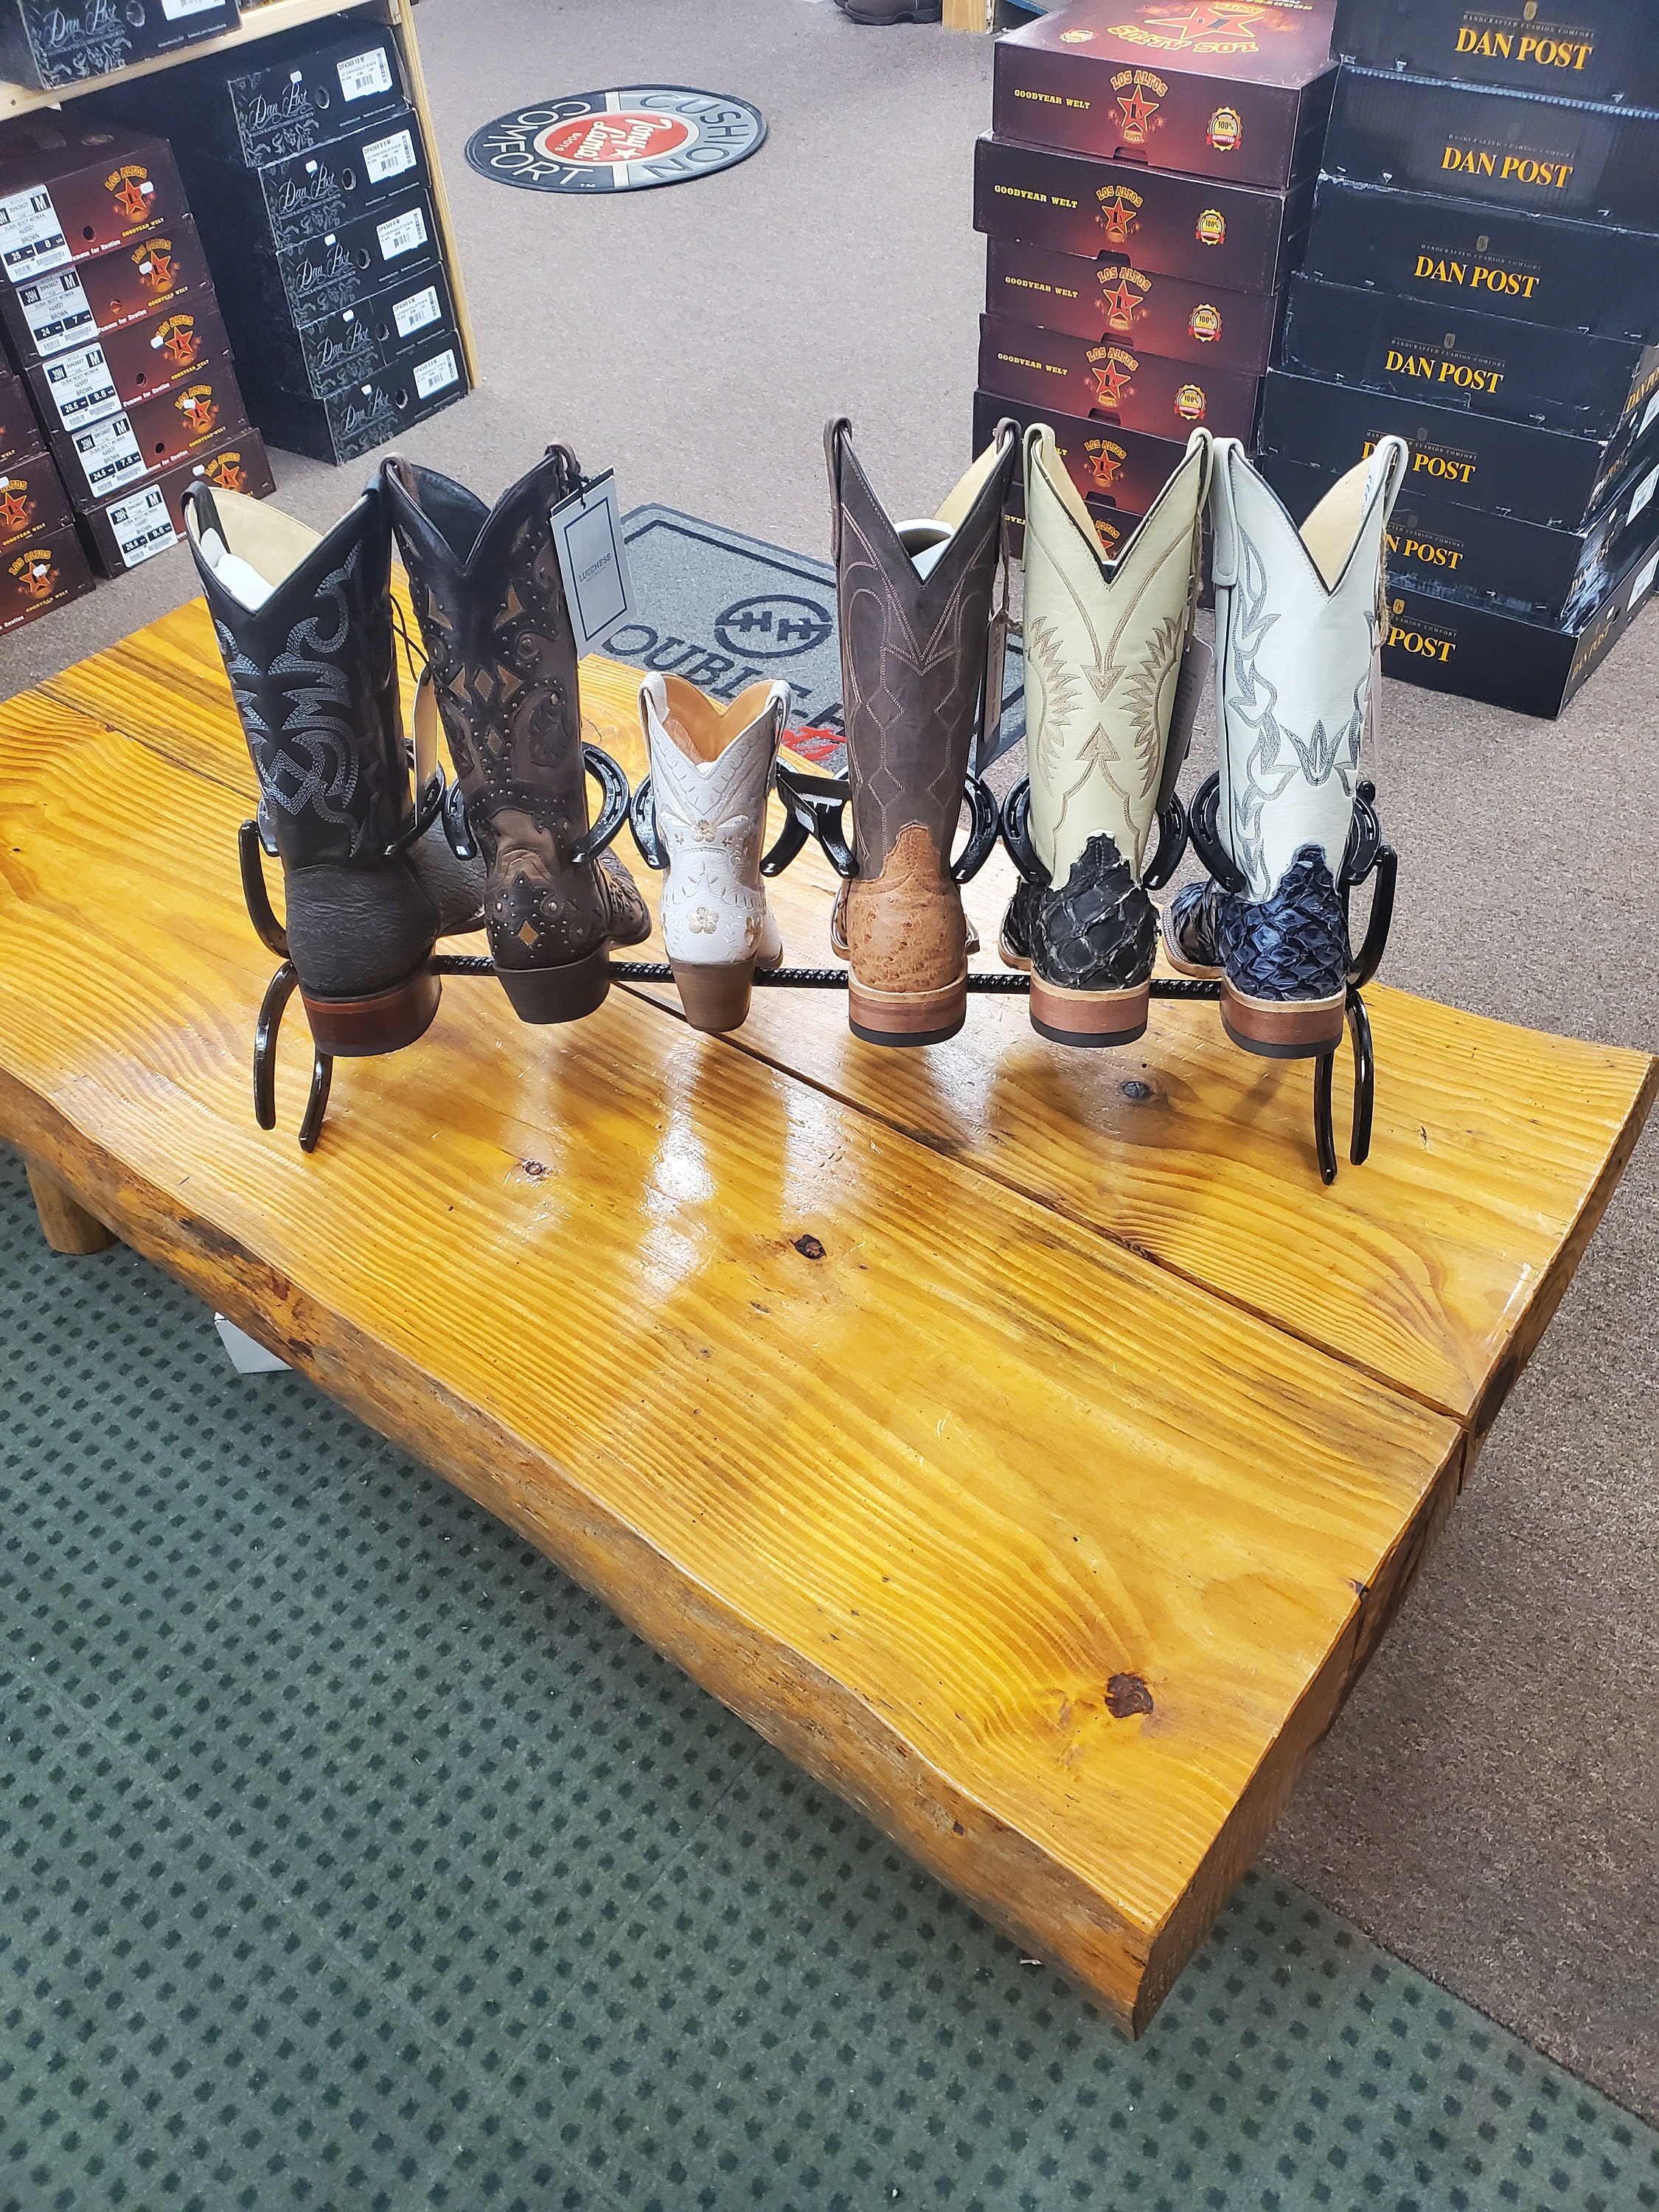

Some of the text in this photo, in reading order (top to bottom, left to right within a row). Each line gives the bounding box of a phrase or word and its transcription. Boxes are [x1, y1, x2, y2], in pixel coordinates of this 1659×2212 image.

[43, 0, 122, 48] Dan Post
[1106, 25, 1192, 51] ALTOS
[1192, 41, 1259, 53] LOS
[1454, 27, 1593, 70] DAN POST
[1110, 69, 1169, 98] LOS ALTOS
[248, 82, 310, 131] Dan Post
[1014, 89, 1091, 109] GOODYEAR WELT
[625, 118, 674, 150] Tony
[639, 94, 750, 179] CUSHION
[1217, 120, 1234, 131] 100%
[484, 101, 594, 184] COMFORT
[554, 132, 582, 152] BOOTS
[574, 119, 629, 161] Lama
[105, 164, 148, 192] LOS ALTOS
[1441, 147, 1574, 189] DAN POST
[279, 162, 336, 214] Dan Post
[994, 185, 1078, 209] GOODYEAR WELT
[1096, 185, 1143, 208] LOS ALTOS
[36, 198, 47, 212] M
[122, 218, 164, 237] GOODYEAR WELT
[1205, 219, 1219, 229] 100%
[21, 233, 41, 244] BROWN
[91, 246, 100, 254] for
[100, 239, 121, 251] Exotics
[11, 250, 21, 260] 25
[131, 240, 172, 264] LOS ALTOS
[296, 241, 352, 293] Dan Post
[1096, 266, 1152, 292] LOS ALTOS
[1413, 255, 1540, 299] DAN POST
[24, 291, 39, 303] 39N
[66, 276, 76, 289] M
[148, 286, 189, 307] GOODYEAR WELT
[1005, 276, 1079, 299] GOODYEAR WELT
[51, 310, 69, 320] BROWN
[128, 309, 147, 321] Exotics
[169, 314, 194, 327] ALTOS
[1198, 315, 1214, 324] 100%
[41, 327, 51, 336] 24
[317, 336, 342, 367] Dan
[347, 319, 370, 352] Post
[53, 369, 66, 381] 39N
[90, 352, 100, 365] M
[170, 359, 209, 380] GOODYEAR WELT
[997, 352, 1068, 376] GOODYEAR WELT
[1085, 347, 1140, 372] LOS ALTOS
[1384, 350, 1504, 394] DAN POST
[76, 386, 93, 397] BROWN
[94, 392, 106, 401] 9.5
[122, 382, 170, 407] Famous for Exotics
[174, 385, 212, 409] LOS ALTOS
[1183, 394, 1199, 404] 100%
[64, 402, 78, 413] 26.5
[341, 403, 365, 434] Dan
[369, 386, 390, 419] Post
[116, 420, 127, 434] M
[1084, 439, 1127, 460] LOS ALTOS
[205, 452, 241, 477] LOS ALTOS
[1411, 452, 1476, 484] POST
[150, 495, 159, 507] M
[3, 523, 46, 546] GOODYEAR WELT
[1095, 520, 1120, 539] ALTOS
[9, 549, 52, 575] LOS ALTOS
[1402, 538, 1464, 570] POST
[579, 553, 611, 582] LUCCHESE
[55, 589, 69, 600] WELT
[4, 615, 24, 627] Exotics
[1424, 624, 1458, 638] COMFORT
[1387, 626, 1456, 663] POST
